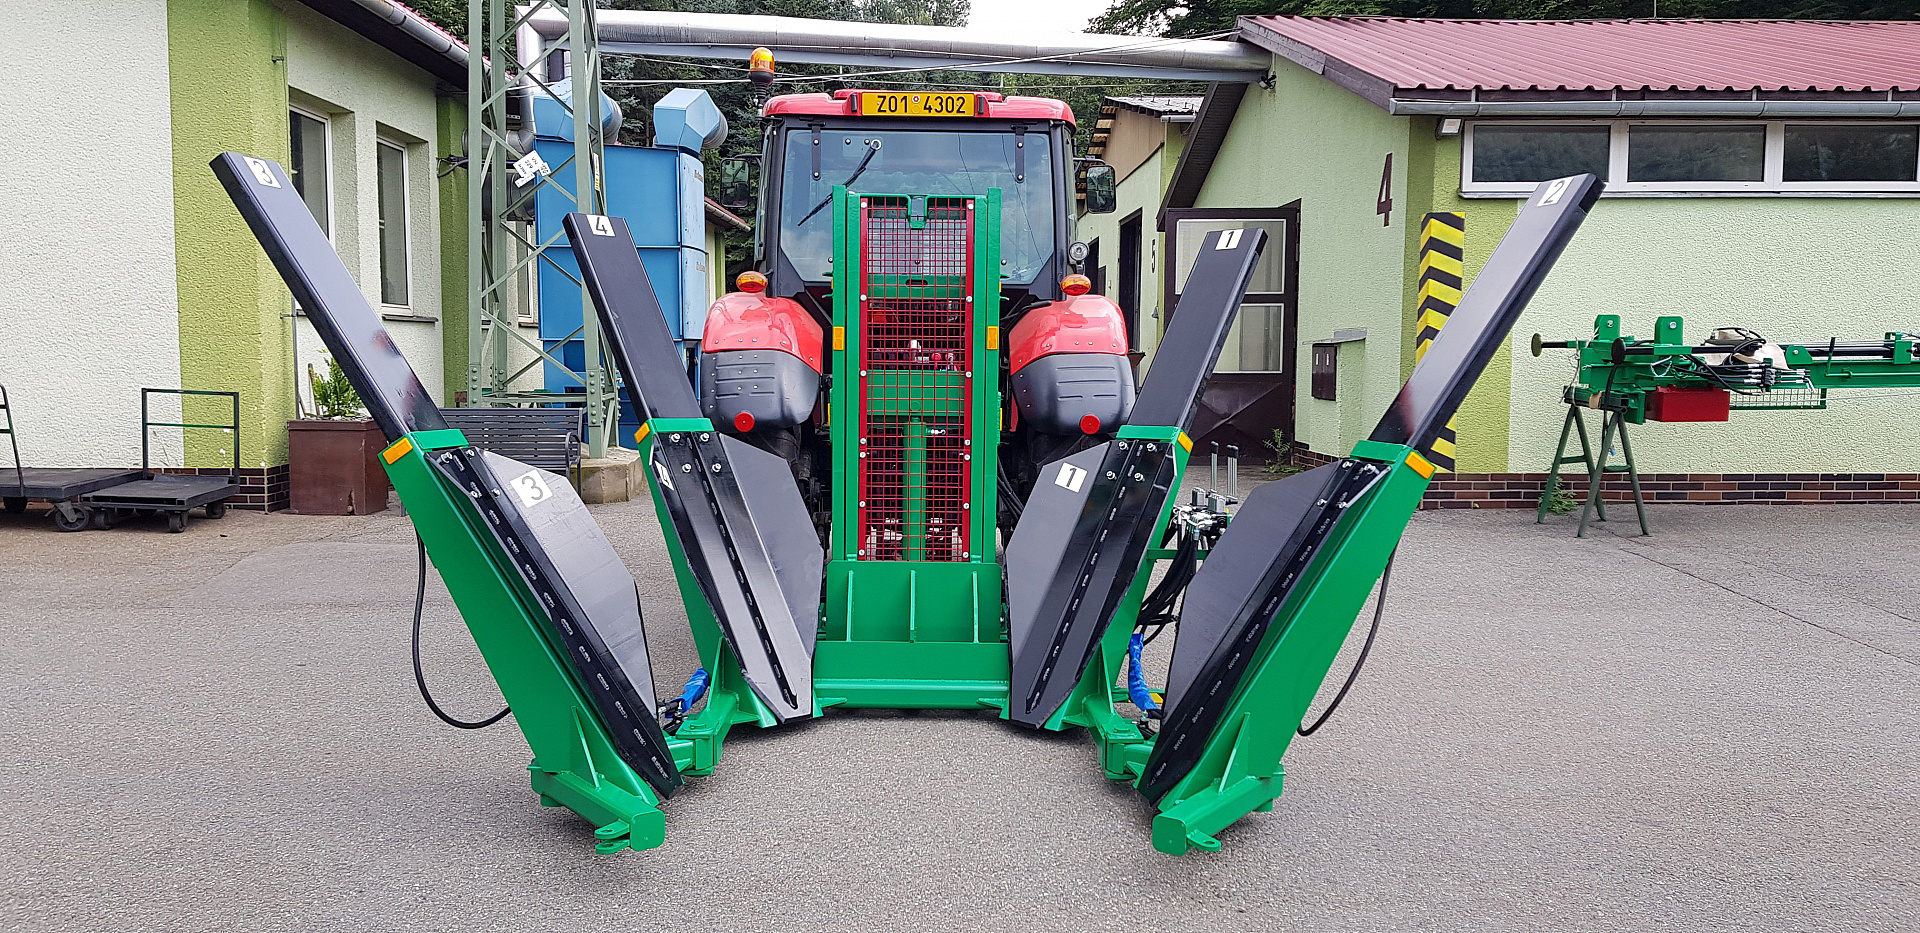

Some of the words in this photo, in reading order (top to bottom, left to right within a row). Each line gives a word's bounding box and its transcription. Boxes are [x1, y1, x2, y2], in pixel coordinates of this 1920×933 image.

[877, 95, 908, 113] Z01
[923, 96, 966, 114] 4302
[252, 160, 273, 185] 3
[1377, 152, 1393, 227] 4
[1542, 179, 1565, 204] 2
[595, 216, 608, 235] 4
[1225, 230, 1235, 248] 1
[1151, 238, 1156, 274] 5
[521, 475, 544, 501] 3
[1066, 467, 1077, 488] 1
